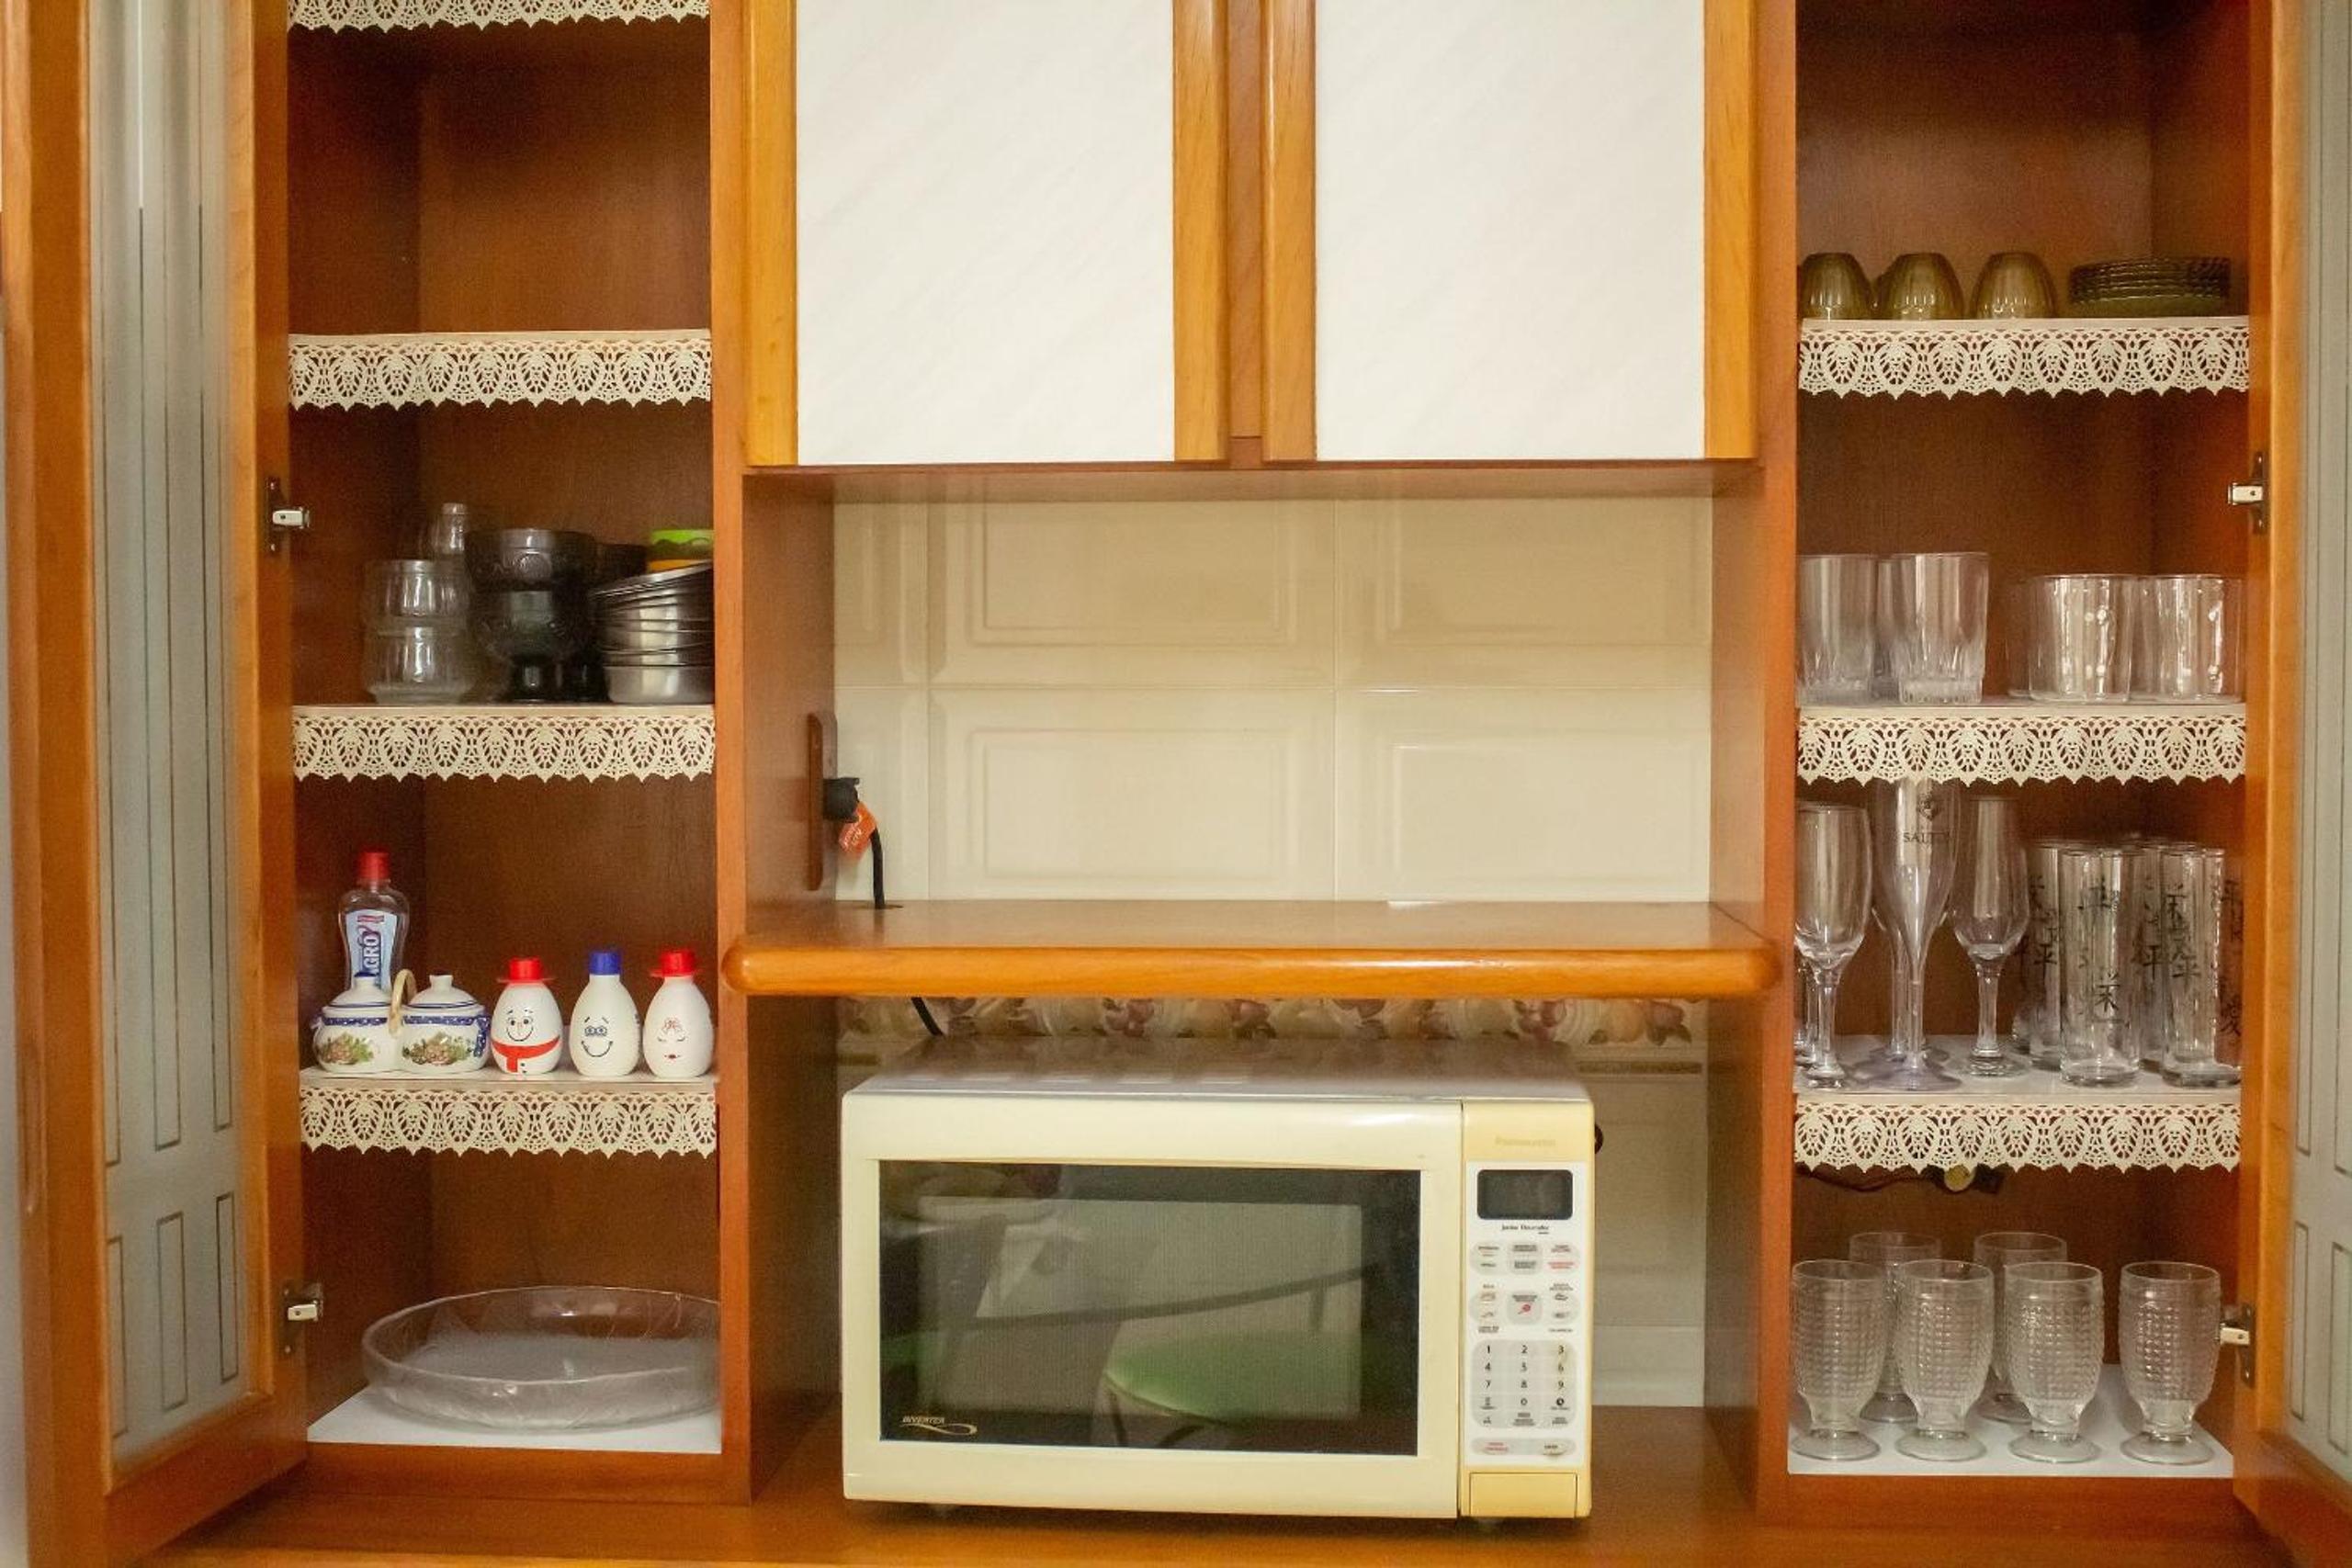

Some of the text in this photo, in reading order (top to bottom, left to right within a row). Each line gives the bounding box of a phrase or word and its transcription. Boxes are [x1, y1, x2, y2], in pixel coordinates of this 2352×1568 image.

[1521, 1344, 1528, 1354] 2
[1558, 1345, 1565, 1355] 3
[1485, 1361, 1491, 1371] 4
[1521, 1361, 1527, 1371] 5
[1558, 1362, 1565, 1372] 6
[1485, 1380, 1491, 1389] 7
[1521, 1380, 1527, 1389] 8
[1558, 1381, 1565, 1391] 9
